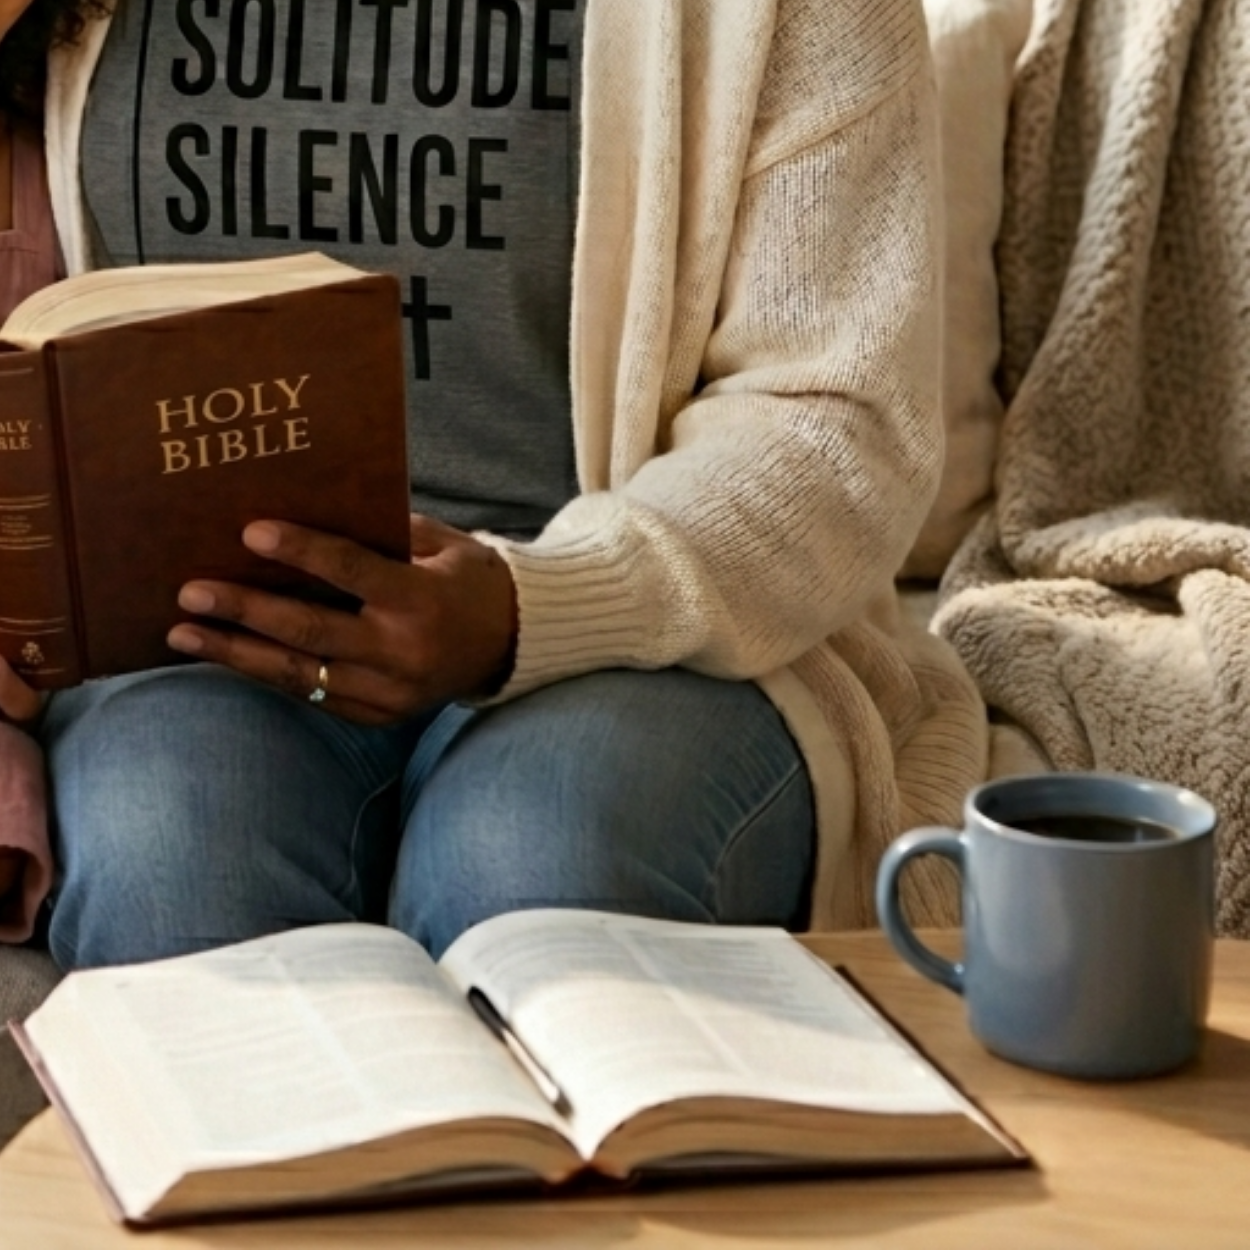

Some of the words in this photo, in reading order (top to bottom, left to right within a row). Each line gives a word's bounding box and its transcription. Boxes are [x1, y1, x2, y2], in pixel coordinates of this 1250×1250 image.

[164, 122, 509, 250] SILENCE
[155, 373, 311, 434] HOLY
[160, 417, 311, 475] BIBLE
